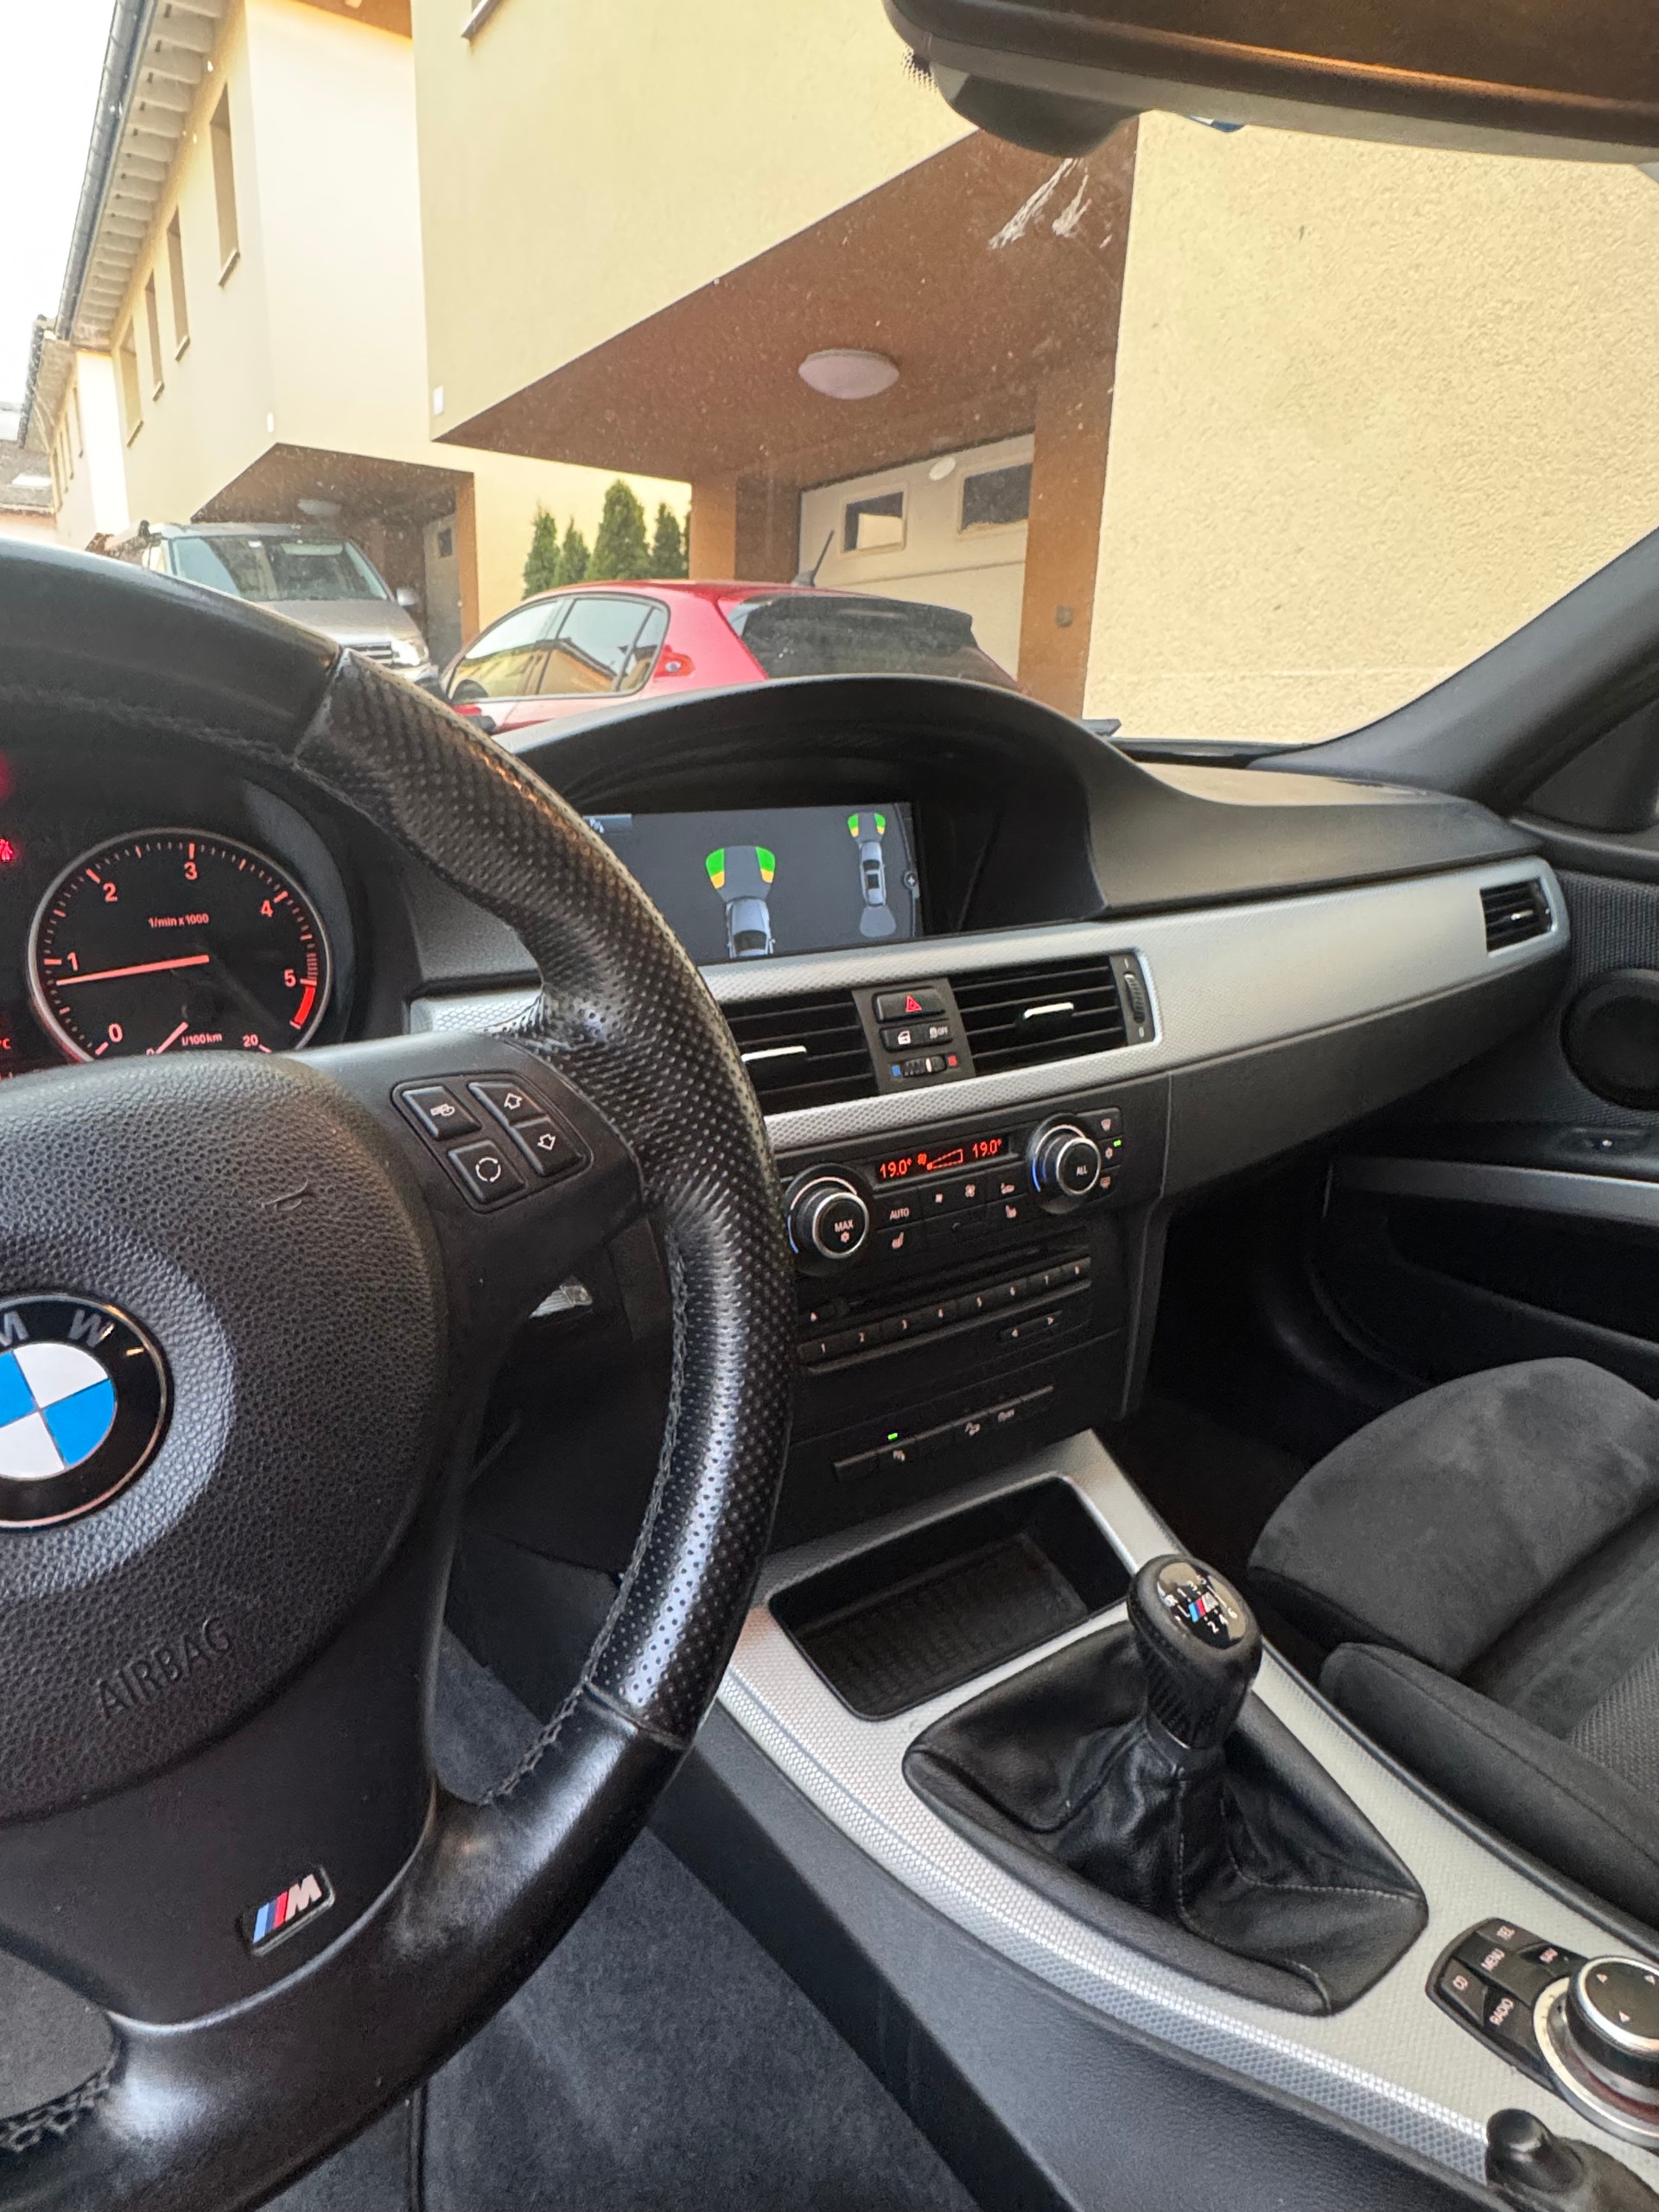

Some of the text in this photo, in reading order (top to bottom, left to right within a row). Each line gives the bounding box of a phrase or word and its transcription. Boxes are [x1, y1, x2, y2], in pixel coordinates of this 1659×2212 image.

[184, 861, 198, 880] 3
[103, 882, 118, 902] 2
[260, 899, 274, 918] 4
[148, 917, 177, 928] 1/min
[185, 912, 209, 925] 1000
[67, 951, 79, 971] 1
[283, 969, 296, 988] 5
[108, 1023, 123, 1043] 0
[242, 1033, 259, 1047] 20
[1076, 1165, 1088, 1176] ALL
[889, 1207, 910, 1220] AUTO
[834, 1218, 854, 1232] MAX
[0, 1309, 115, 1348] MW
[1186, 1580, 1198, 1591] 3
[1227, 1607, 1238, 1619] 6
[1207, 1621, 1219, 1634] 2
[96, 1618, 231, 1719] AIRBAG
[1481, 1948, 1505, 1972] MENU
[1489, 1998, 1514, 2026] RADIO
